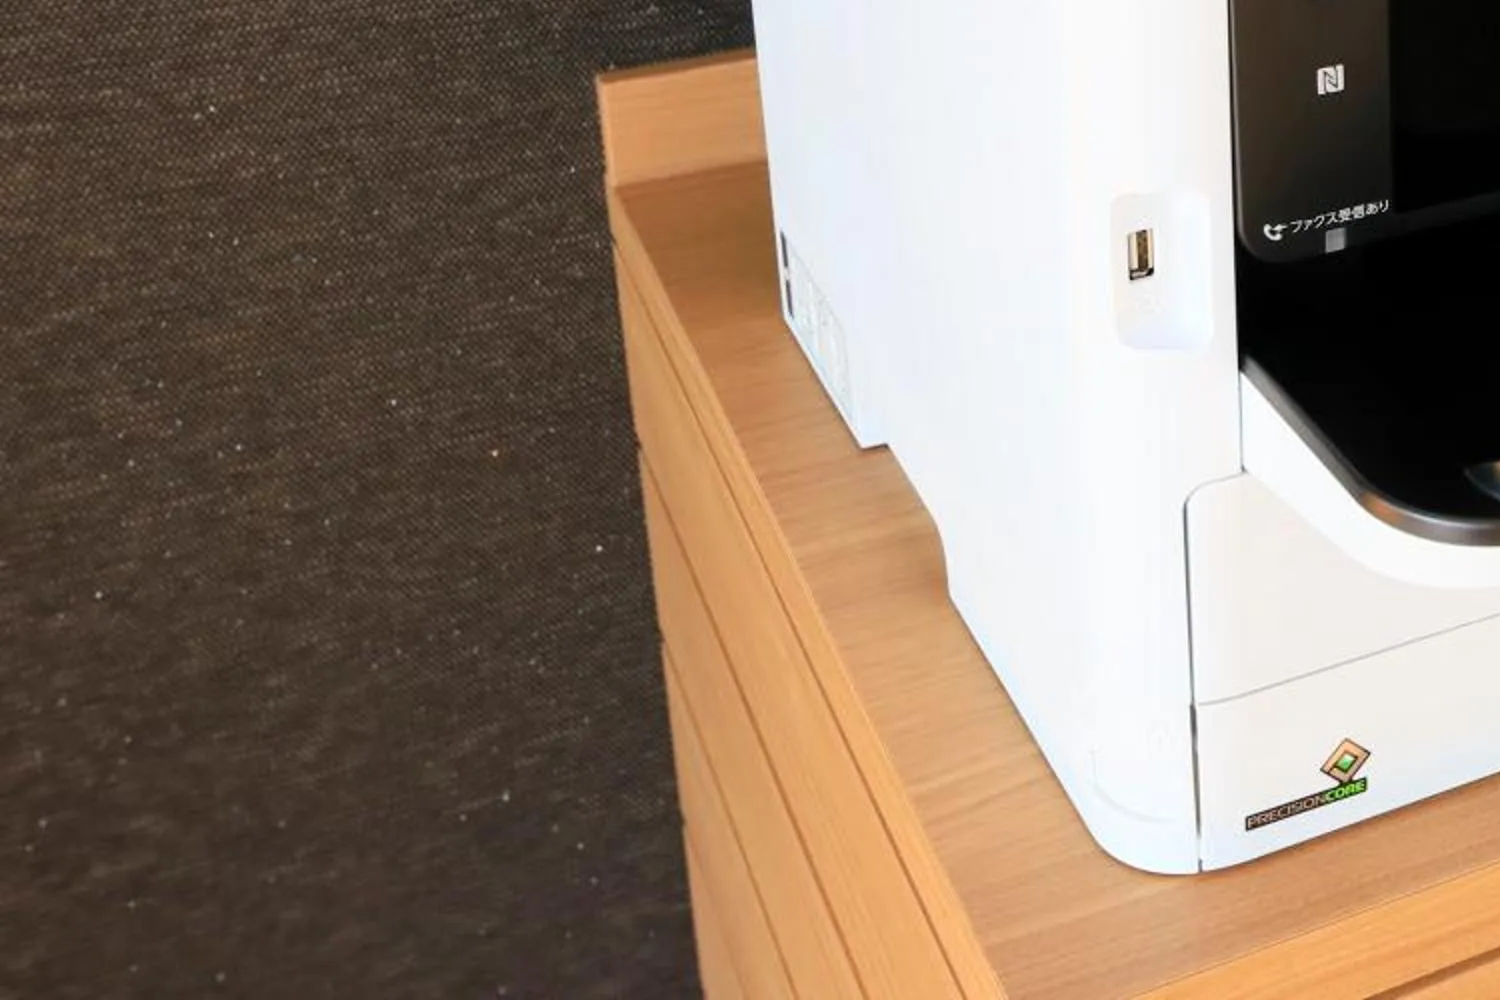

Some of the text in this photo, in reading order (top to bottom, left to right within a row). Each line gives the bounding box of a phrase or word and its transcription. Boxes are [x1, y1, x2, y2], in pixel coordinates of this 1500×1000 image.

[1290, 199, 1389, 233] ファクス受信あり
[1247, 778, 1367, 830] PRECISIONCORE
